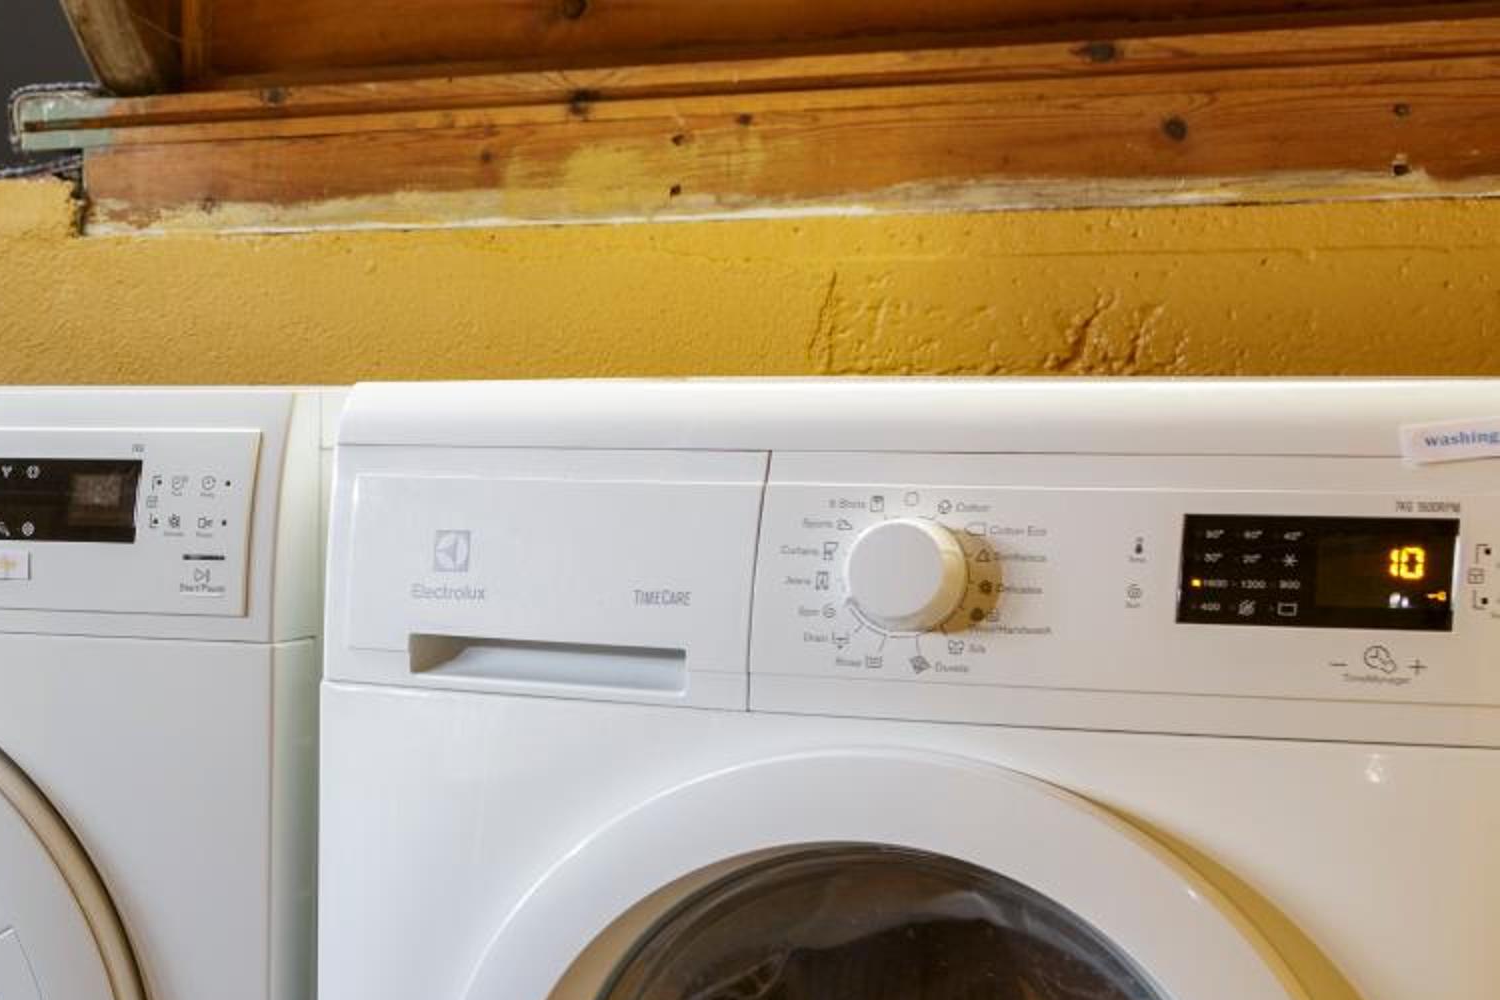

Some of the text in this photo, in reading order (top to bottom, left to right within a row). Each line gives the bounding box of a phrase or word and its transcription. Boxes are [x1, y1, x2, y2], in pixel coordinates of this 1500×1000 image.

[1424, 430, 1500, 447] washing
[1389, 546, 1426, 580] 10
[410, 582, 486, 602] Electrolux
